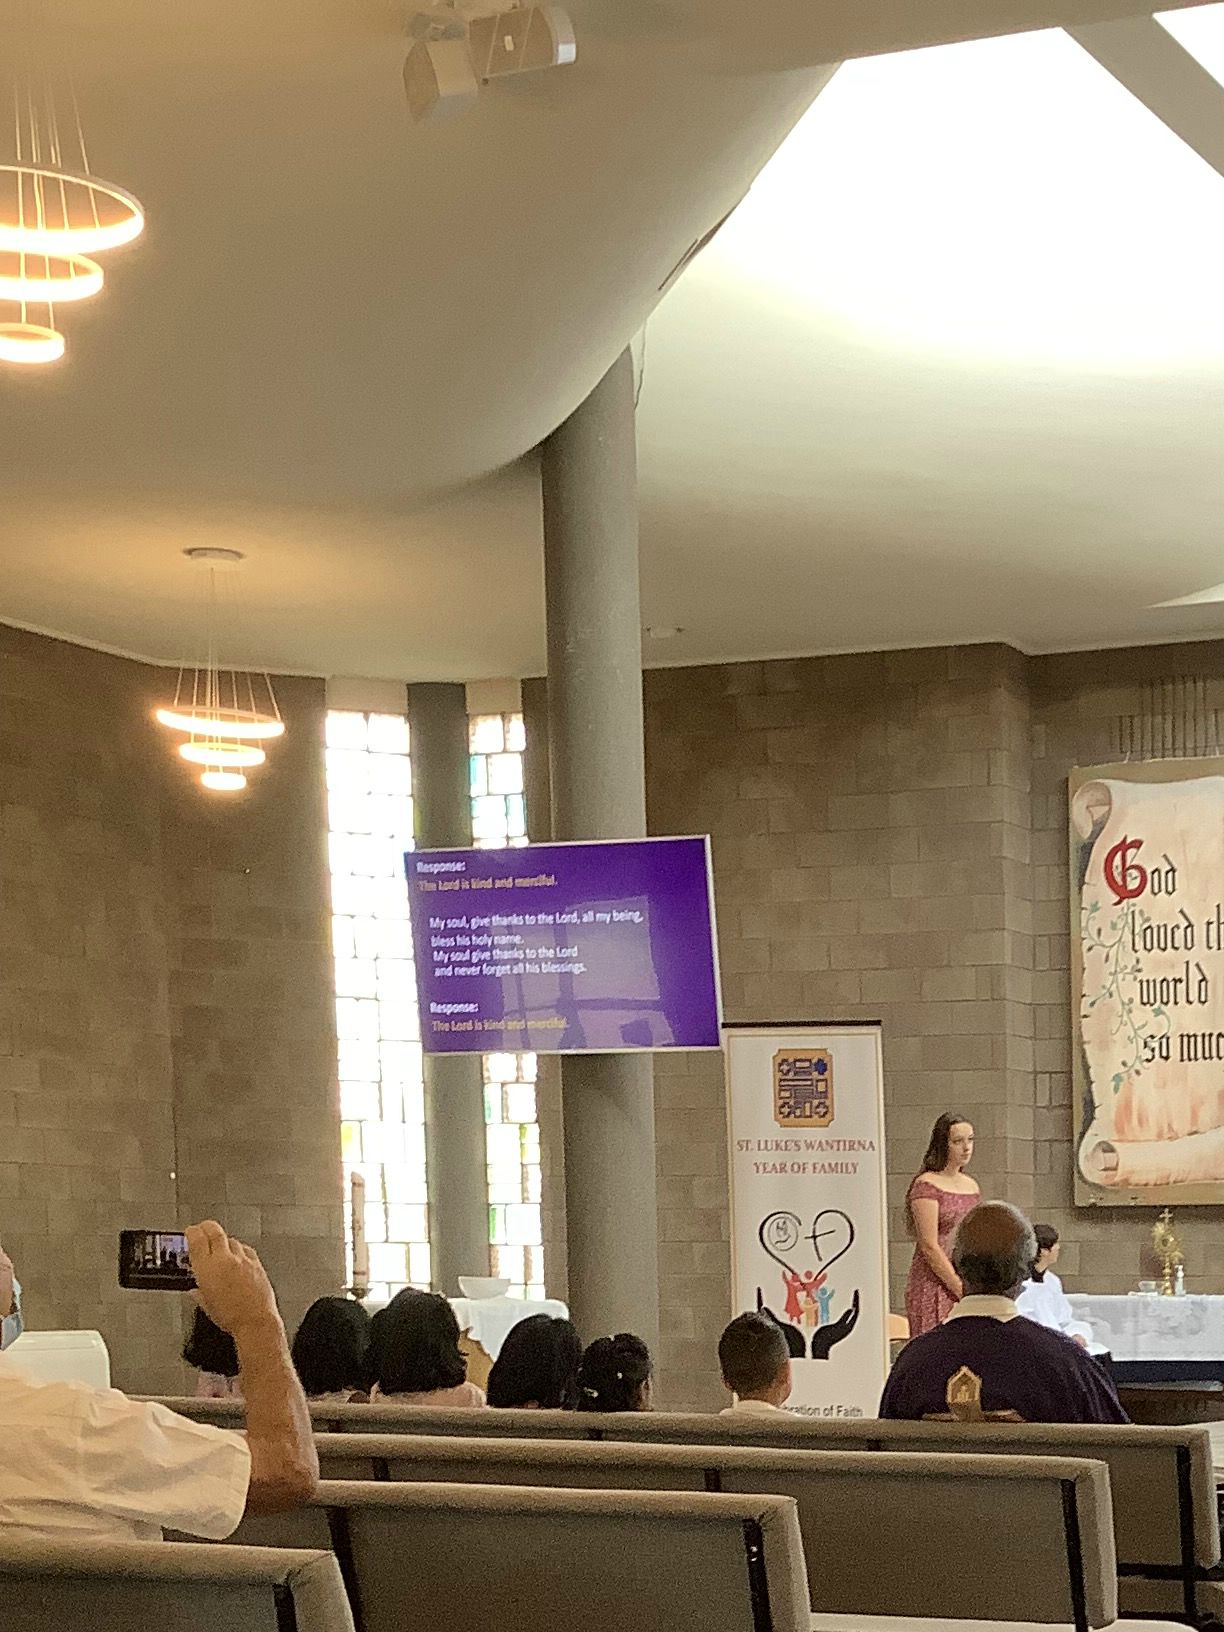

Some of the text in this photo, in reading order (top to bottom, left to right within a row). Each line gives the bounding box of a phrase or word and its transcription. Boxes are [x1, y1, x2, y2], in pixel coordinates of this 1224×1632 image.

[416, 861, 466, 874] Response:
[1103, 834, 1178, 906] God
[430, 917, 445, 930] My
[471, 916, 490, 929] give
[492, 913, 523, 926] thanks
[525, 914, 535, 925] to
[538, 913, 554, 925] the
[556, 911, 580, 924] Lord,
[582, 911, 594, 922] all
[596, 913, 611, 924] my
[1131, 907, 1195, 954] loved
[431, 935, 455, 947] bless
[457, 934, 470, 946] his
[472, 933, 492, 947] holy
[433, 946, 578, 963] My soul give thanks to the Lord
[434, 965, 453, 977] and
[454, 965, 480, 976] never
[482, 963, 511, 977] forget
[512, 963, 524, 974] all
[526, 963, 540, 974] his
[1138, 960, 1209, 1006] world
[430, 1002, 479, 1015] Response:
[1142, 1031, 1171, 1063] so
[736, 1139, 876, 1152] ST. LUKE'S WANTIRNA
[753, 1161, 860, 1175] YEAR OF FAMILY
[822, 1404, 834, 1417] of
[836, 1404, 864, 1417] Faith
